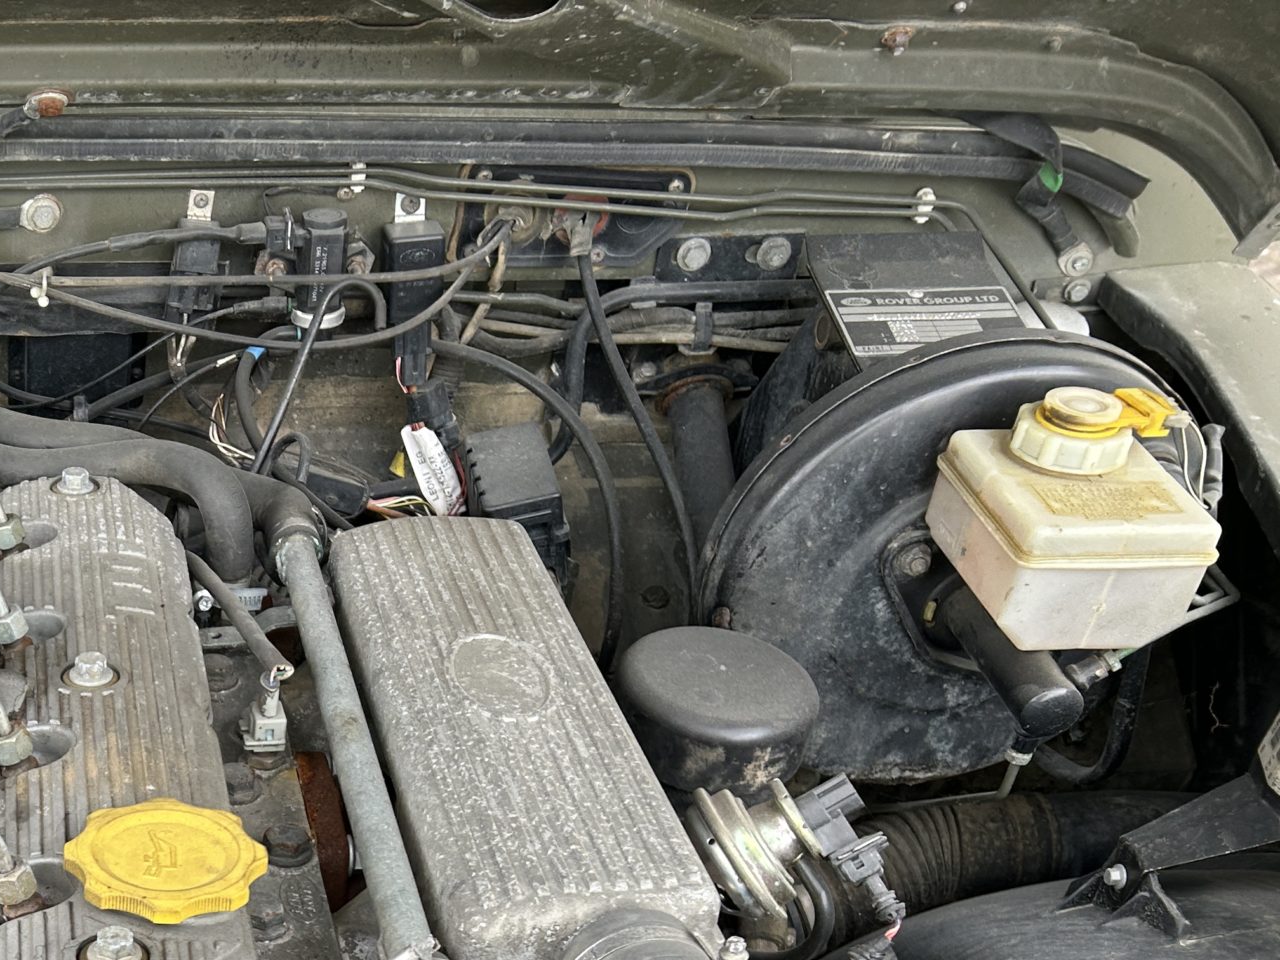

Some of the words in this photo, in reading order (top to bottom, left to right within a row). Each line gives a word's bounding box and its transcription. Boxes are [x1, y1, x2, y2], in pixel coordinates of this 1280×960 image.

[876, 297, 923, 306] ROVER
[926, 295, 973, 306] GROUP
[975, 294, 1000, 304] LTD
[422, 472, 440, 501] LEONI
